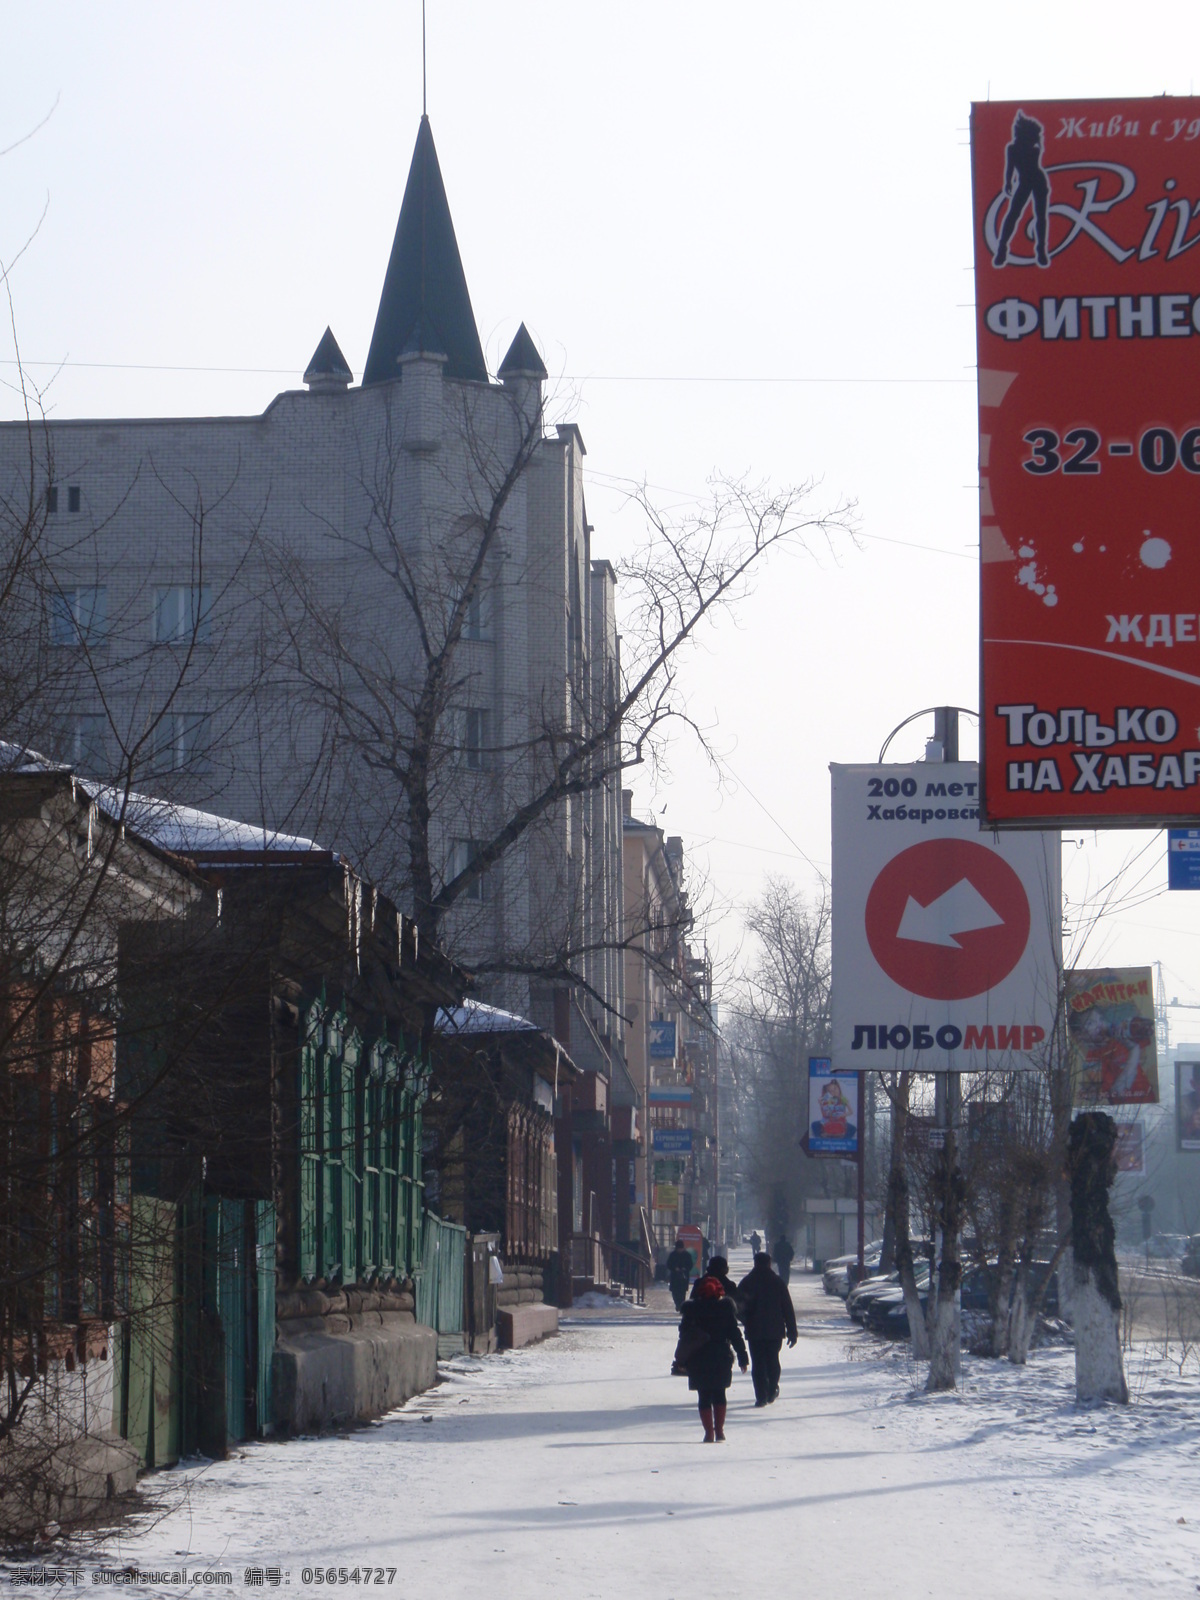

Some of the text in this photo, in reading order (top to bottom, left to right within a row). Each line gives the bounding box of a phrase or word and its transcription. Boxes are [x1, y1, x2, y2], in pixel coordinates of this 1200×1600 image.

[1054, 114, 1140, 139] Живи
[1150, 118, 1162, 136] с
[985, 294, 1200, 341] ФИТНЕ
[1105, 614, 1200, 648] ЖДЕ
[867, 777, 978, 798] 200 мет
[1007, 757, 1063, 793] НА
[1069, 979, 1149, 1012] НАПИТКИ
[851, 1023, 1046, 1051] ЛЮБОМИР
